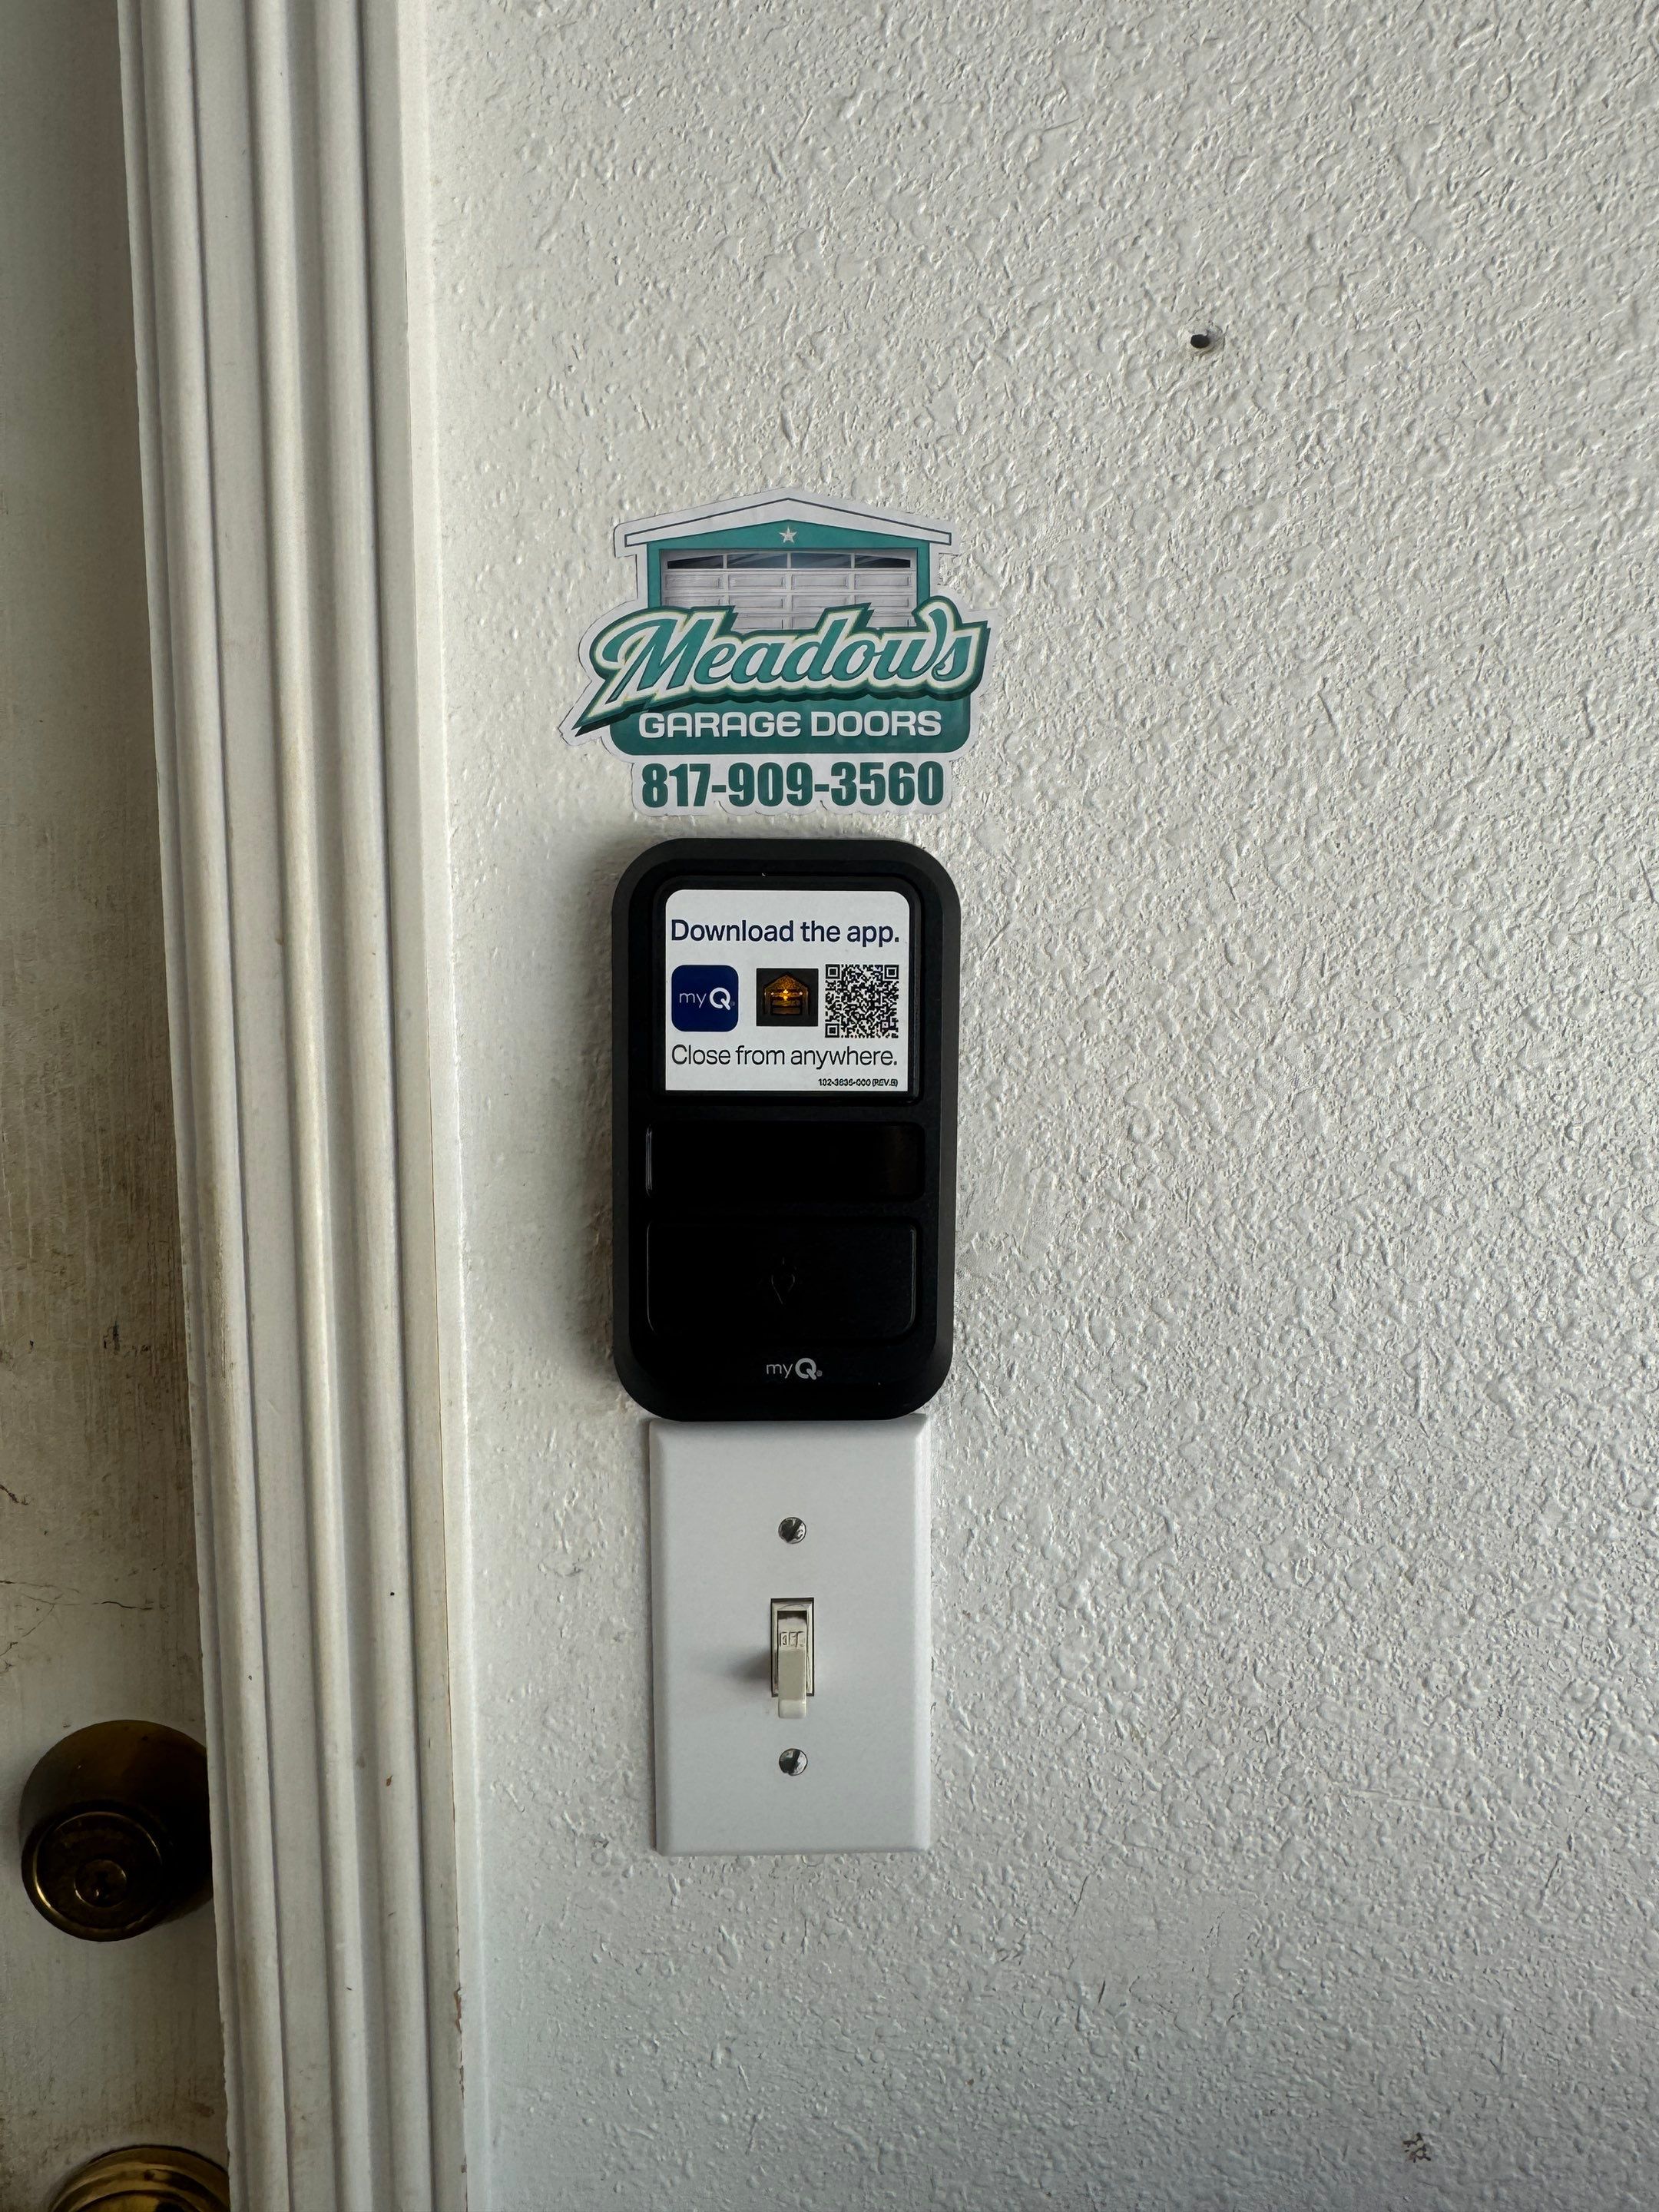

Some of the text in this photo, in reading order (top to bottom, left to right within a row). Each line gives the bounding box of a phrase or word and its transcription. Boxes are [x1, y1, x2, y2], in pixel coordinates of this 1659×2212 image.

[582, 598, 986, 718] Meadows
[638, 710, 942, 737] GARAGE DOORS
[641, 761, 944, 807] 817-909-3560
[671, 919, 900, 948] Download the app.
[671, 1044, 898, 1070] Close from anywhere.
